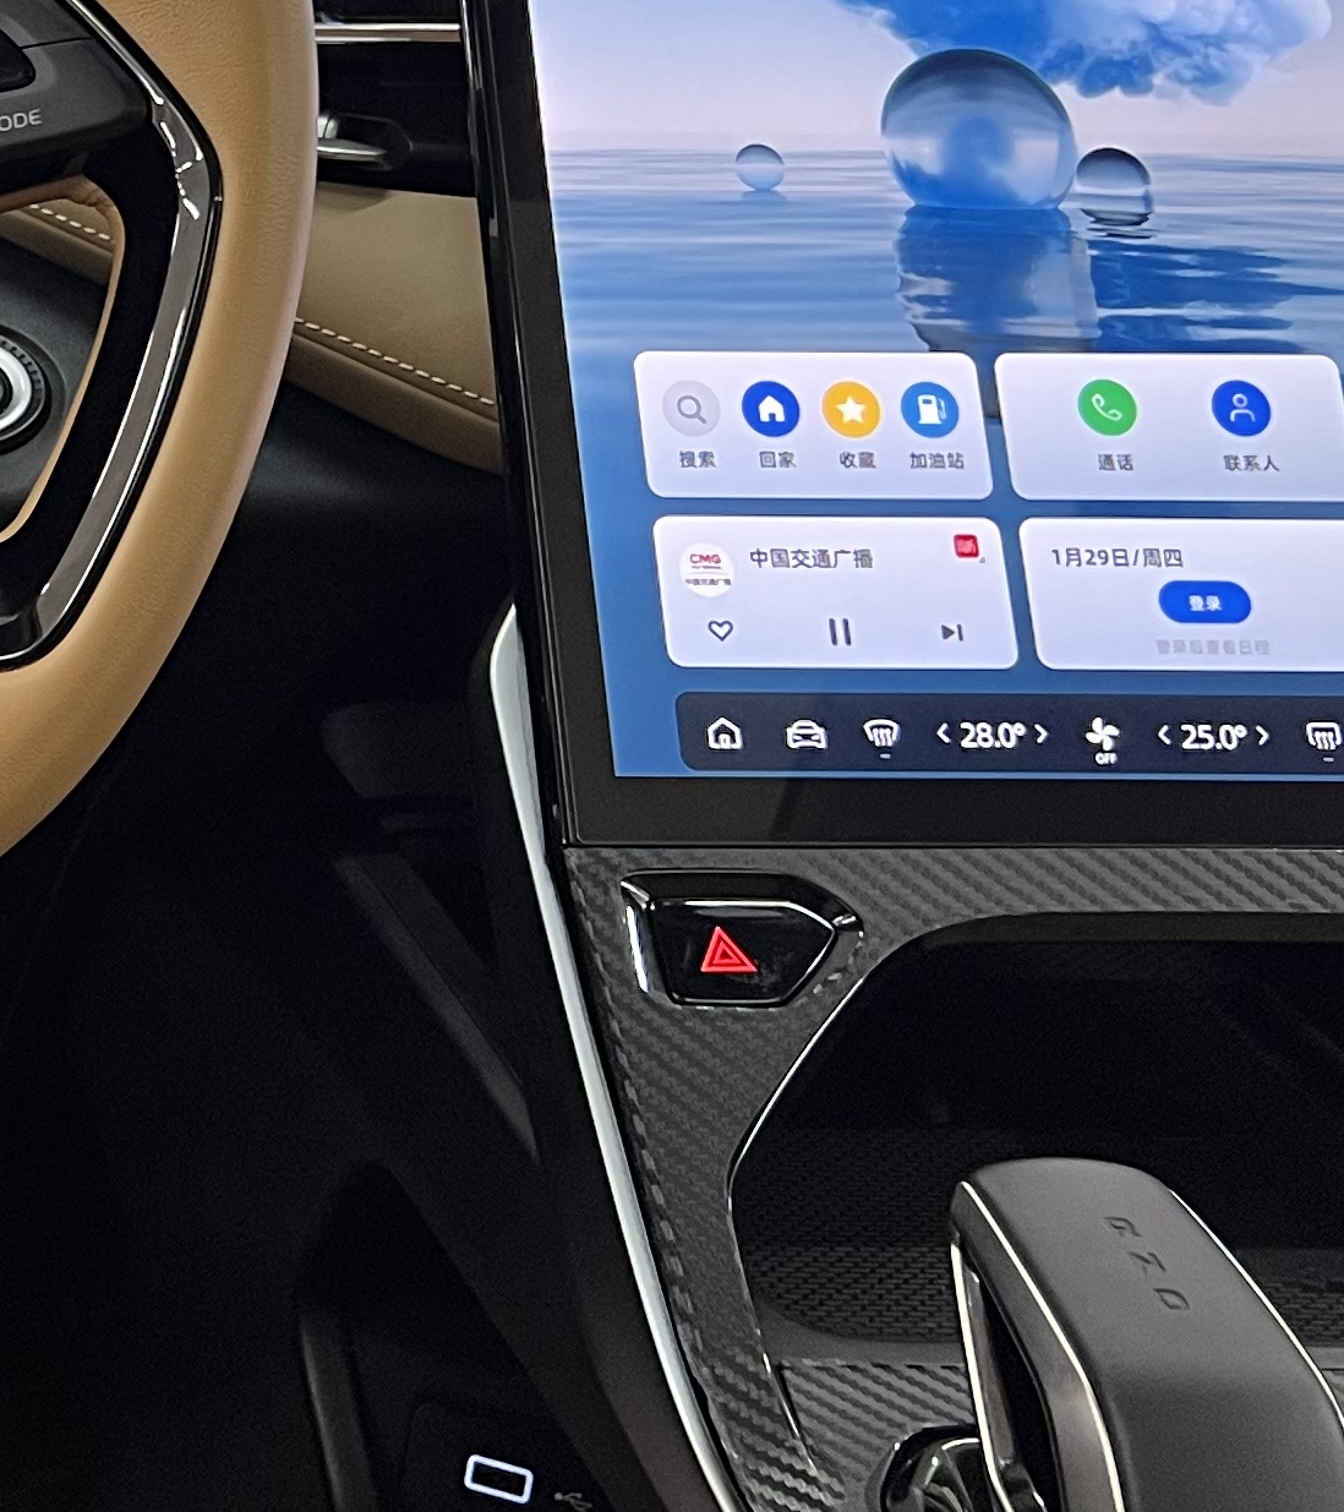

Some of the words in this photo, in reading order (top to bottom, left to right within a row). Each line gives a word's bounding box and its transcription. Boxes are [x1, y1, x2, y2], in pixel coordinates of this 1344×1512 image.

[679, 450, 716, 468] 搜索
[759, 451, 796, 469] 回家
[839, 451, 877, 469] 收藏
[910, 452, 965, 470] 加油站
[1097, 454, 1133, 471] 通话
[1223, 454, 1280, 472] 联系人
[690, 554, 721, 564] CMG
[750, 548, 873, 569] 中国交通广播
[1052, 548, 1183, 568] 1月29日/周四
[1189, 595, 1222, 612] 登录
[1095, 753, 1118, 765] OFF
